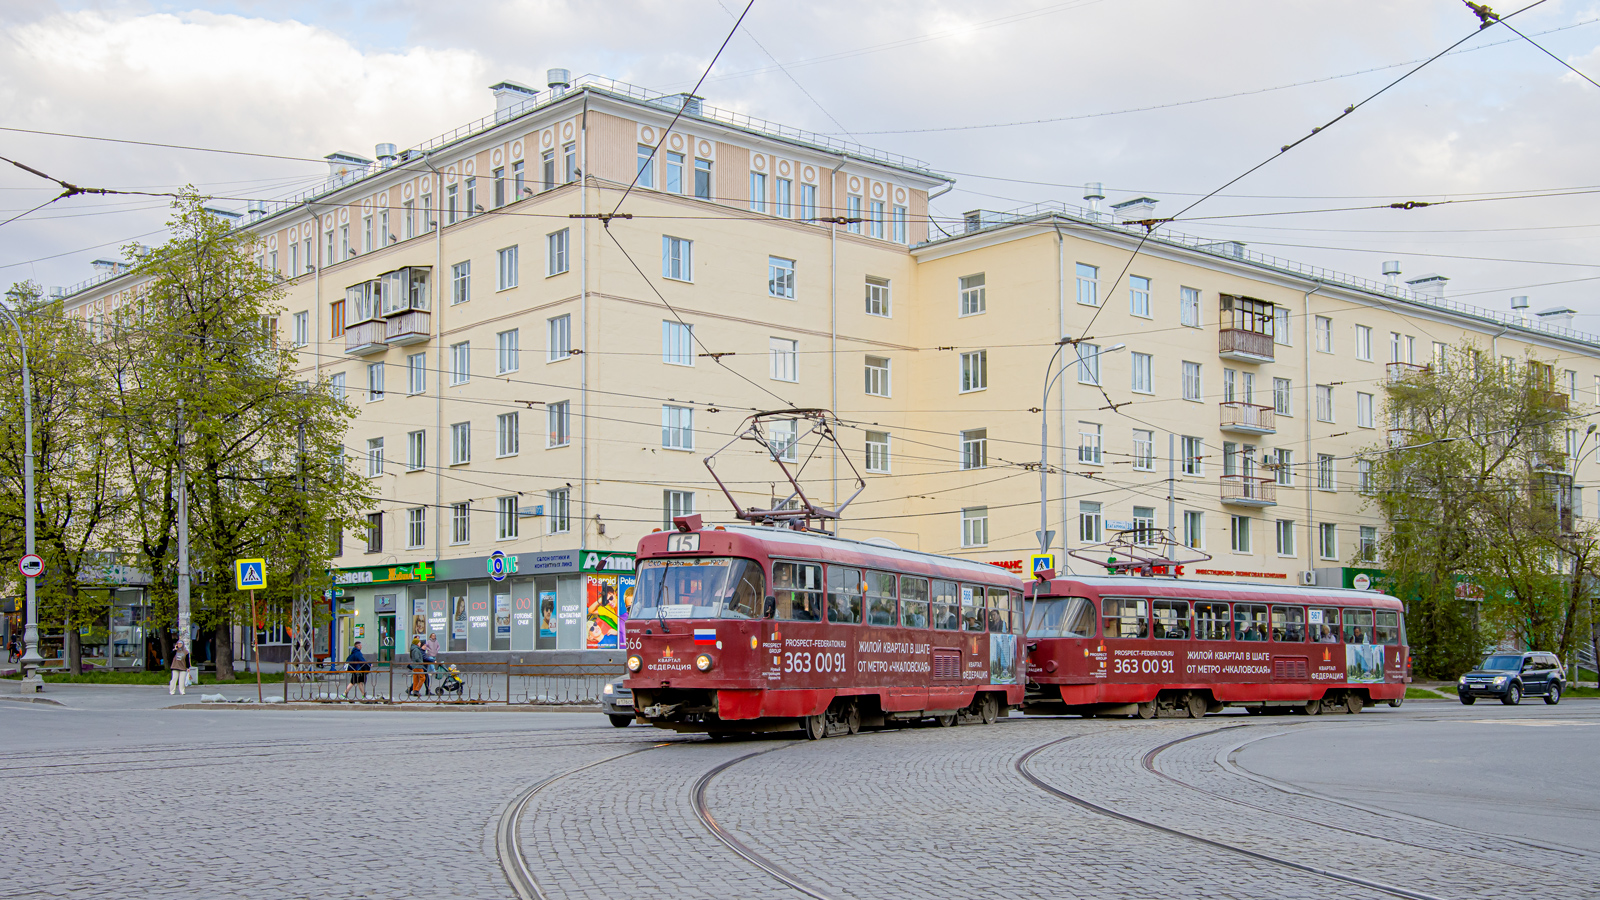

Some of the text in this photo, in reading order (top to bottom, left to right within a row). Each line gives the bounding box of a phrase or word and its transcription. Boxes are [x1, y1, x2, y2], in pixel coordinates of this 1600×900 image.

[676, 536, 693, 551] 15
[487, 555, 519, 574] ФОКУС
[587, 576, 617, 585] Poaroid
[859, 639, 930, 654] ЖИЛОЙ КВАРТАЛ В ШАГЕ
[1187, 650, 1270, 661] ЖИЛОЙ КВАРТАЛ В ШАГЕ
[784, 652, 847, 673] 363 00 91
[857, 661, 931, 672] ОТ МЕТРО «ЧКАЛОВСКАЯ»
[1114, 659, 1174, 673] 363 00 91
[962, 671, 988, 680] ФЕДЕРАЦИЯ
[1186, 665, 1271, 674] ОТ МЕТРО «ЧКАЛОВСКАЯ»
